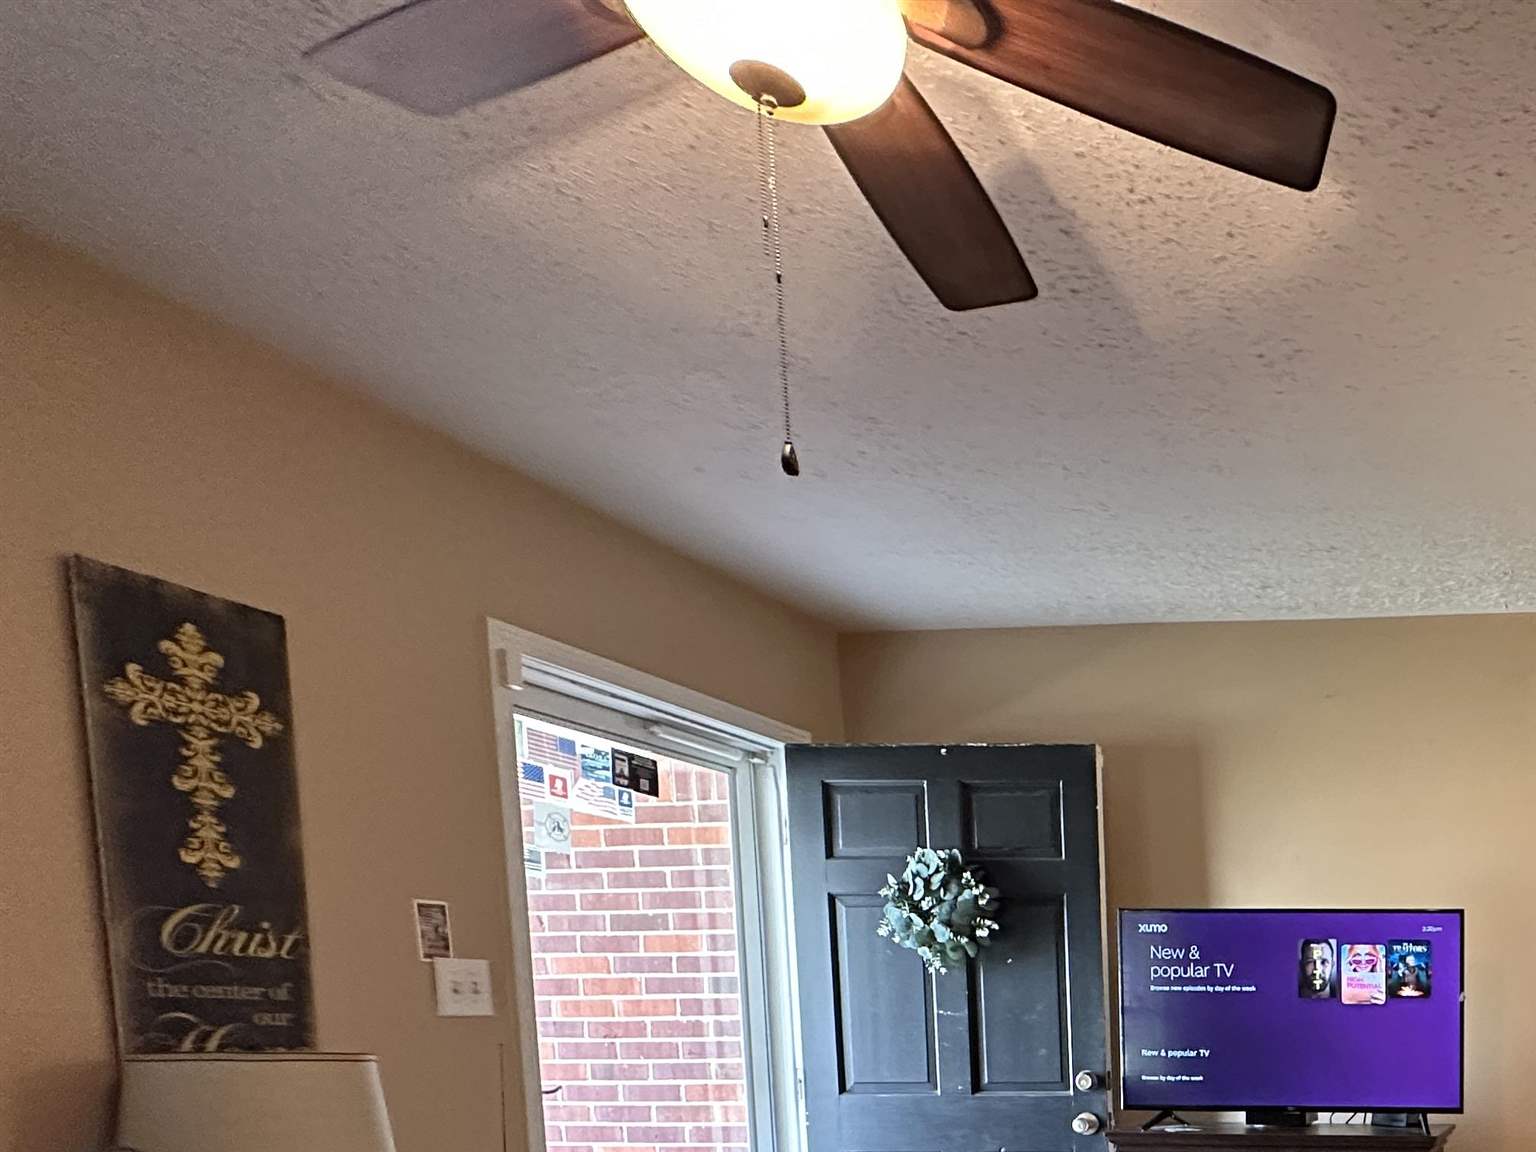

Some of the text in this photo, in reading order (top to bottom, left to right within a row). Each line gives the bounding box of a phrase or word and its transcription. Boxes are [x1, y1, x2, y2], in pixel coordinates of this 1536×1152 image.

[160, 903, 304, 959] Christ
[1138, 923, 1168, 933] xumo
[1150, 945, 1200, 959] New &
[1150, 962, 1235, 981] popular TV
[1168, 1049, 1198, 1058] popular
[1199, 1049, 1210, 1057] TV
